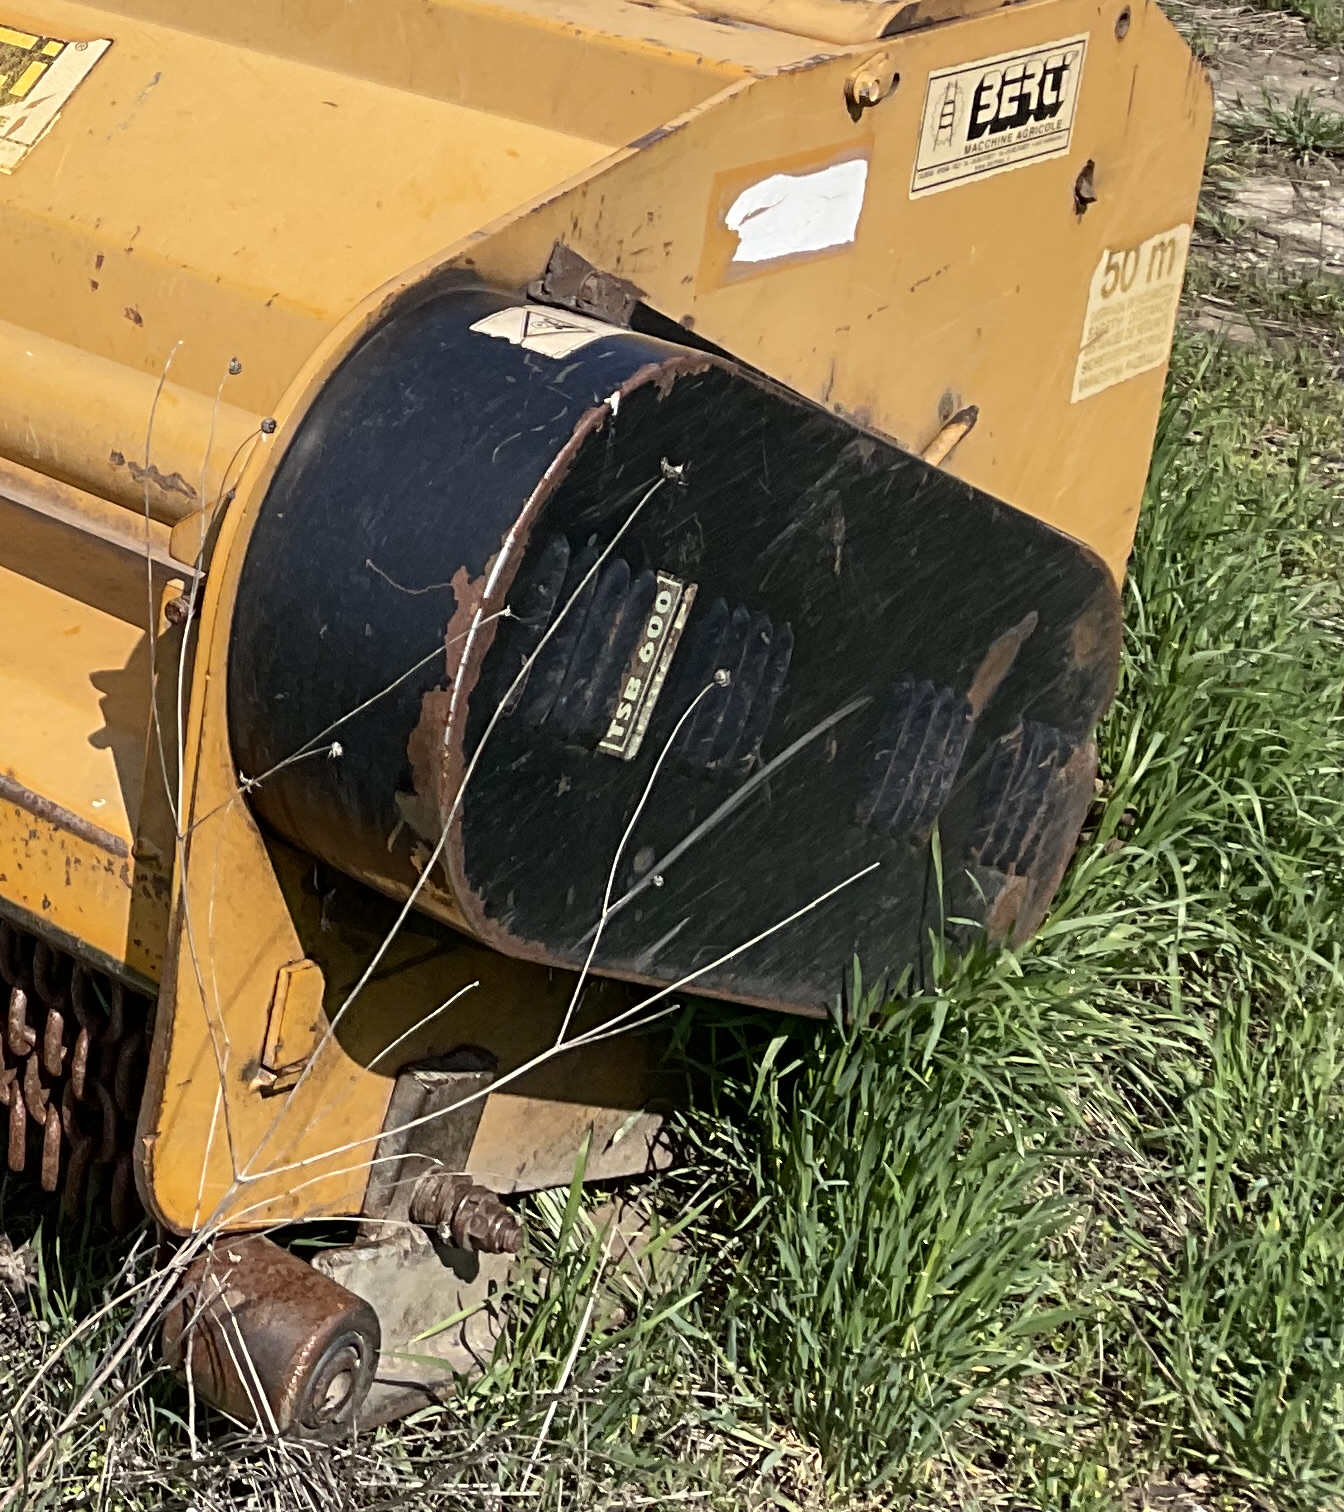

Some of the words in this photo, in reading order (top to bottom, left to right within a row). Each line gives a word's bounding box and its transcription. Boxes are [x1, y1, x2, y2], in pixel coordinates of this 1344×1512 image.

[963, 132, 1014, 156] MACCHINE
[1016, 118, 1064, 142] AGRICOLE
[1100, 247, 1141, 300] 50
[1145, 237, 1177, 284] m
[606, 675, 643, 739] TSB
[638, 590, 673, 664] 600
